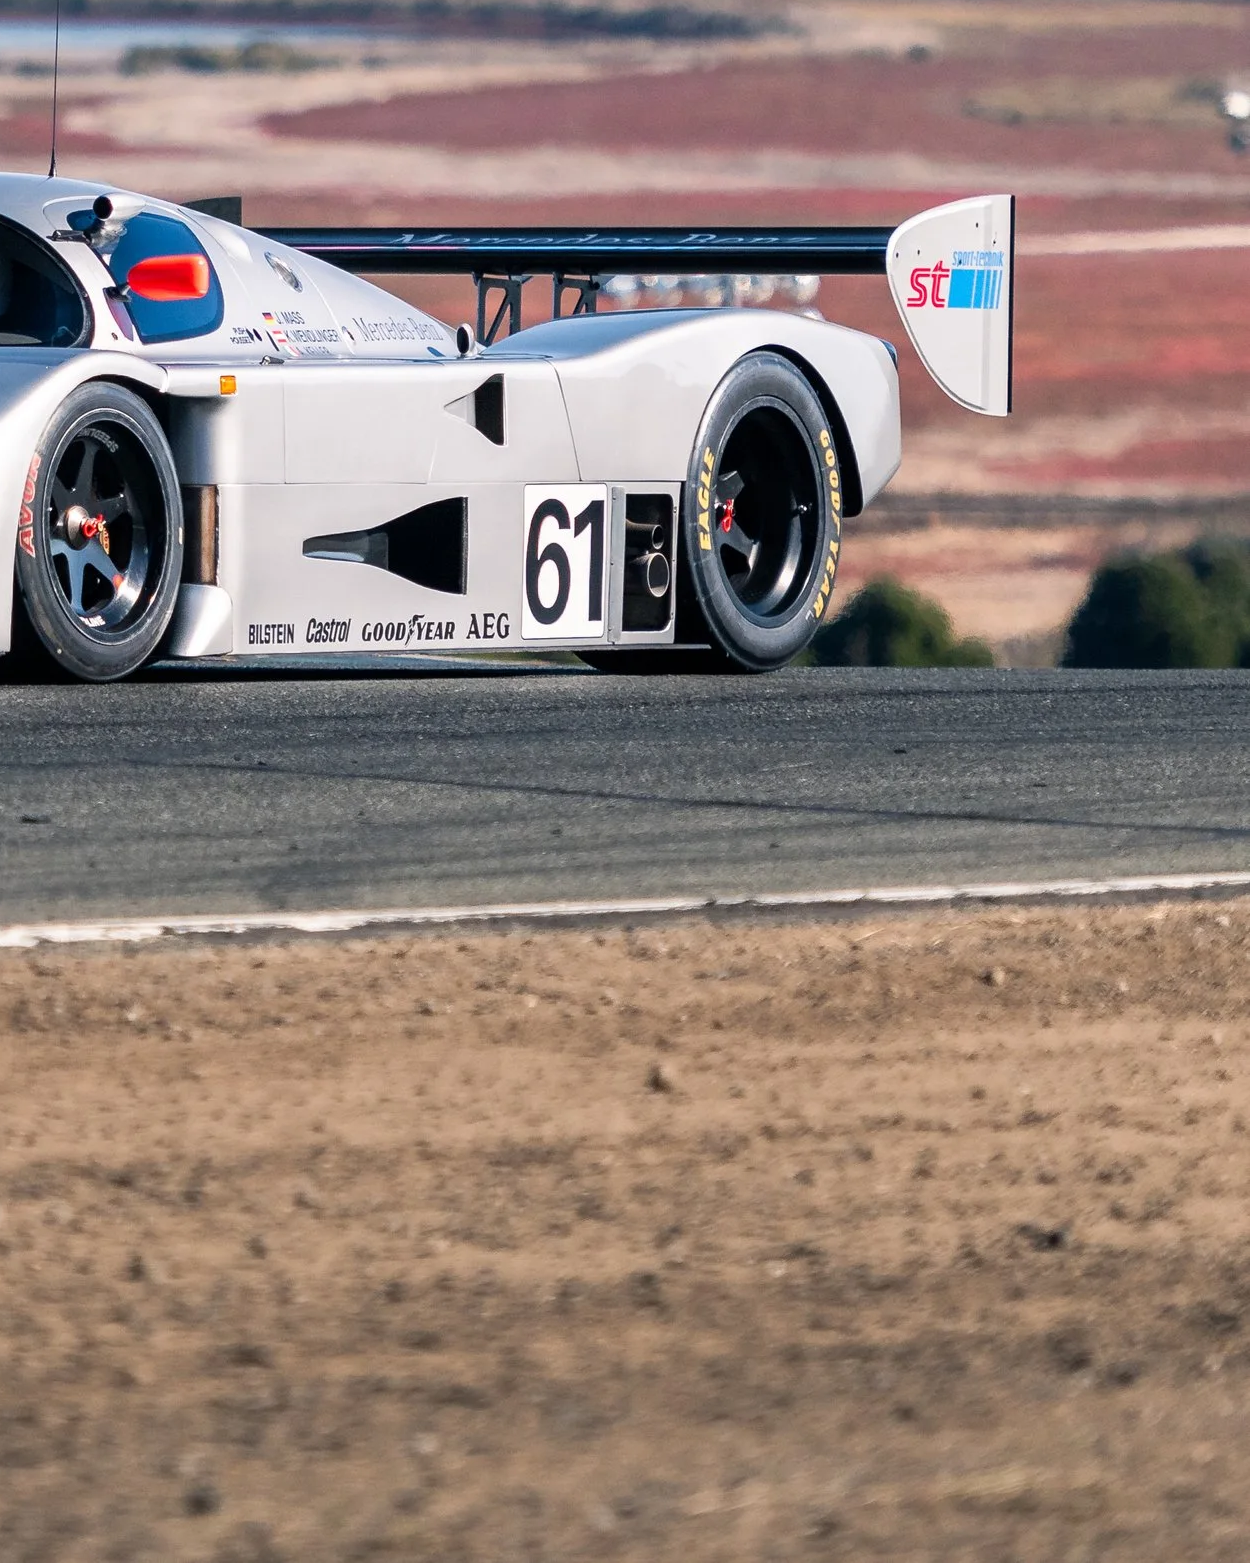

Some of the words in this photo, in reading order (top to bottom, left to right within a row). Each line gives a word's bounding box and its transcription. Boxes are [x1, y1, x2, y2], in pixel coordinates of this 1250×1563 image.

[282, 311, 306, 325] MASS
[352, 317, 444, 342] Mercedes-Benz
[697, 446, 715, 551] EAGLE
[526, 498, 605, 625] 61
[248, 624, 295, 645] BILSTEIN
[305, 618, 351, 643] Castrol
[361, 619, 456, 643] GOODYEAR
[466, 613, 510, 639] AEG
